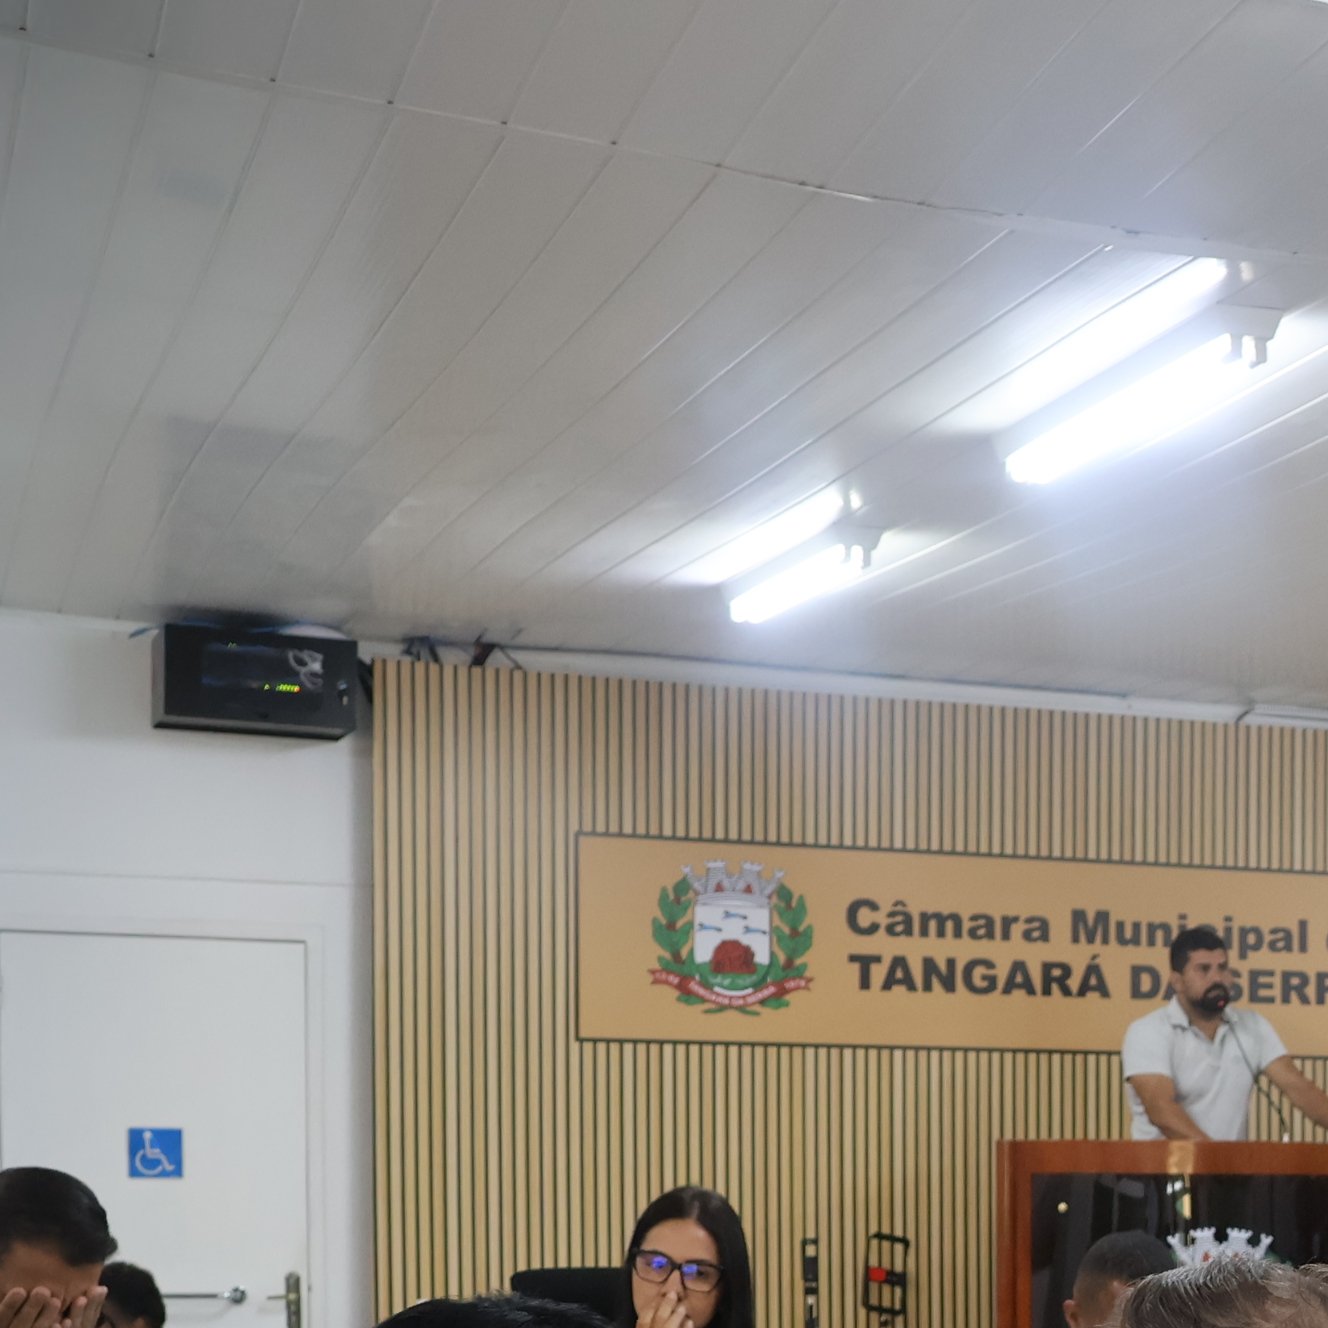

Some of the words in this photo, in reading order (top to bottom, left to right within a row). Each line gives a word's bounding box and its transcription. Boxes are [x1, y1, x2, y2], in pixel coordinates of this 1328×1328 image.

[846, 898, 1050, 943] Câmara
[1070, 908, 1308, 960] Munipal
[847, 953, 1112, 999] TANGARÁ
[1130, 964, 1178, 1000] D
